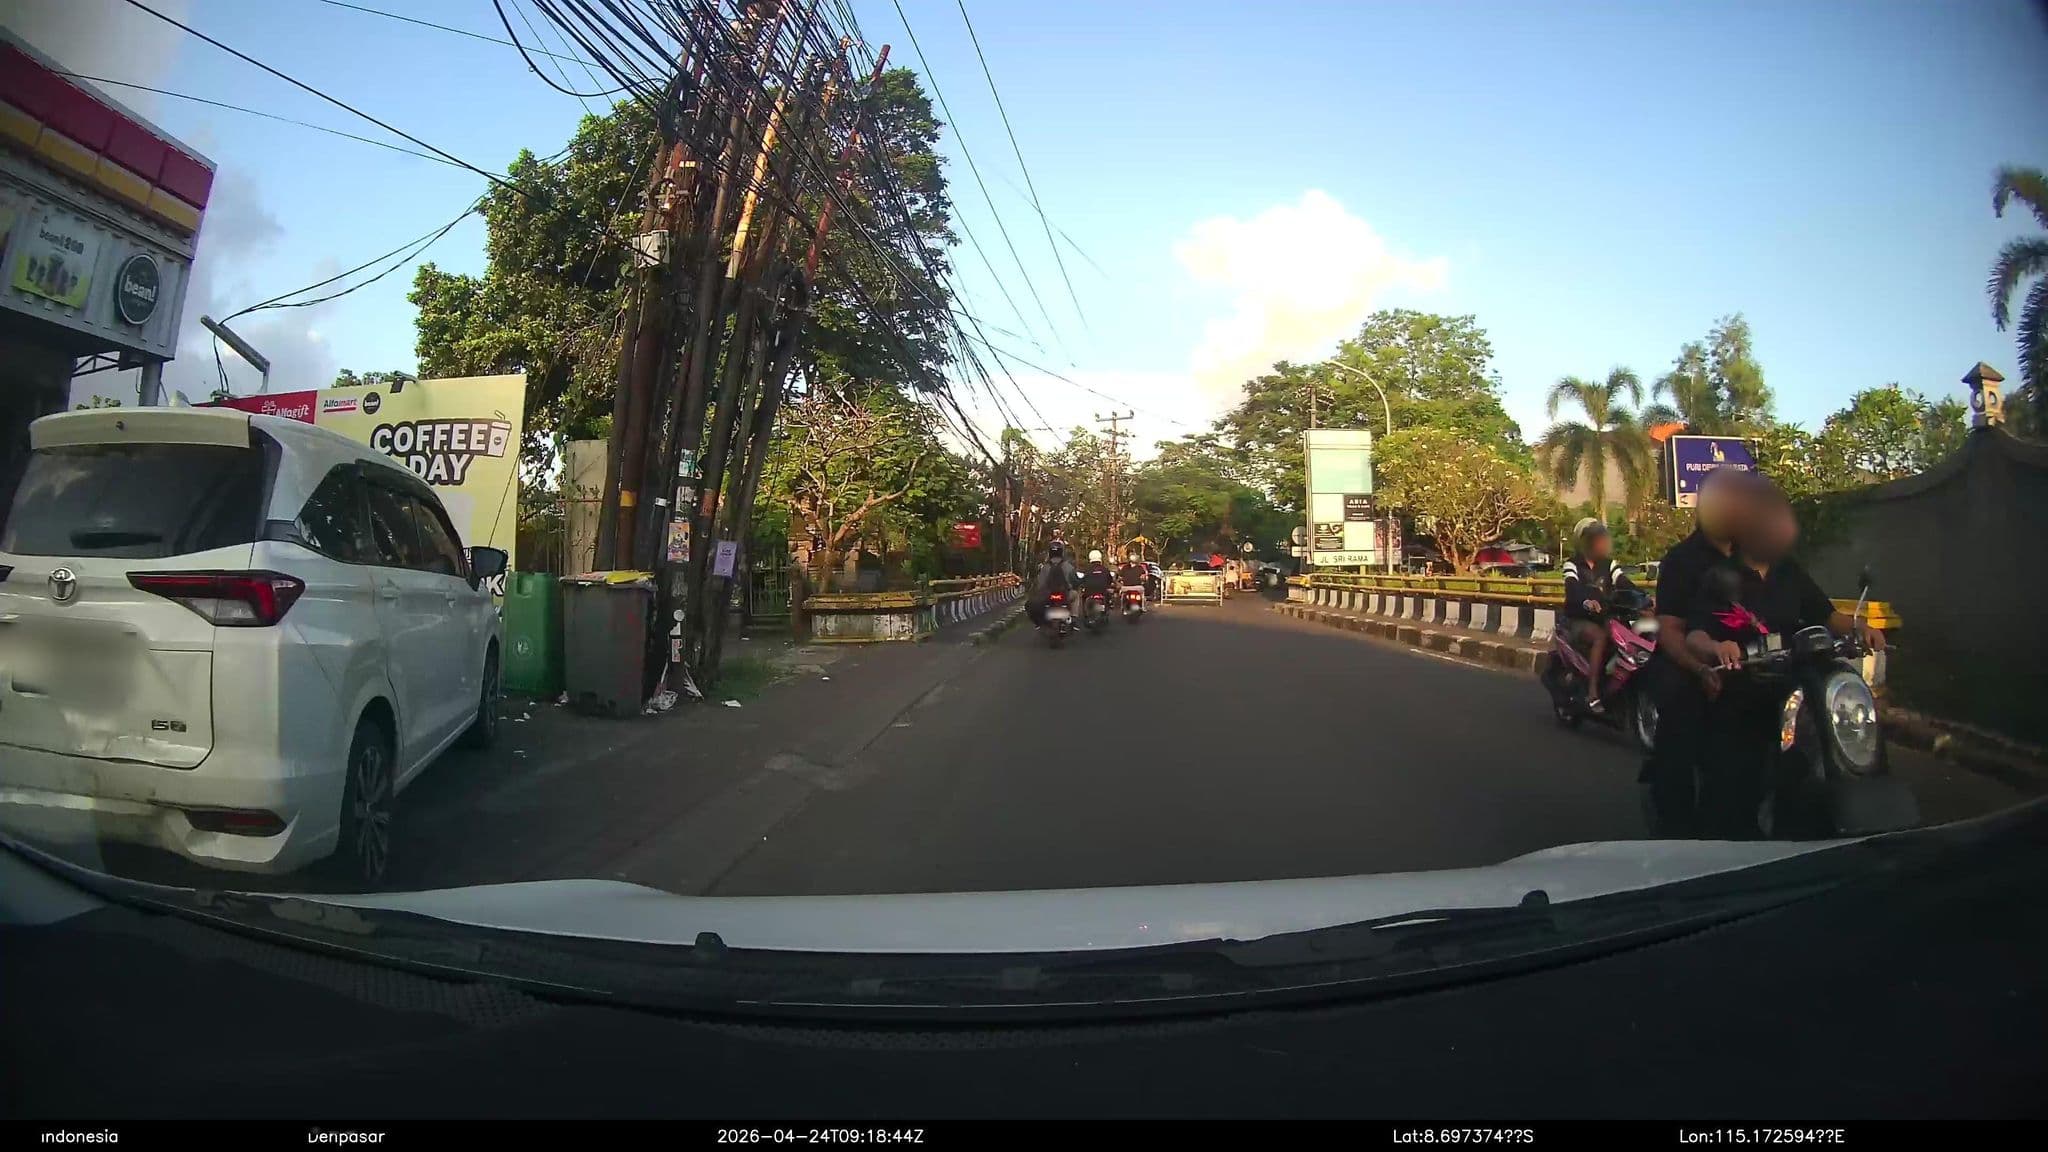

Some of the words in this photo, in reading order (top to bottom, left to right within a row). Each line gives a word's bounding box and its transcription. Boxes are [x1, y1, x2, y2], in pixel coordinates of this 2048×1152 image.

[124, 275, 157, 302] bean!
[275, 404, 310, 419] Alfagift
[323, 398, 357, 408] Alfamart
[372, 422, 490, 455] COFFEE
[409, 453, 471, 481] DAY
[1333, 554, 1346, 563] SRI
[1347, 554, 1369, 562] RAMA
